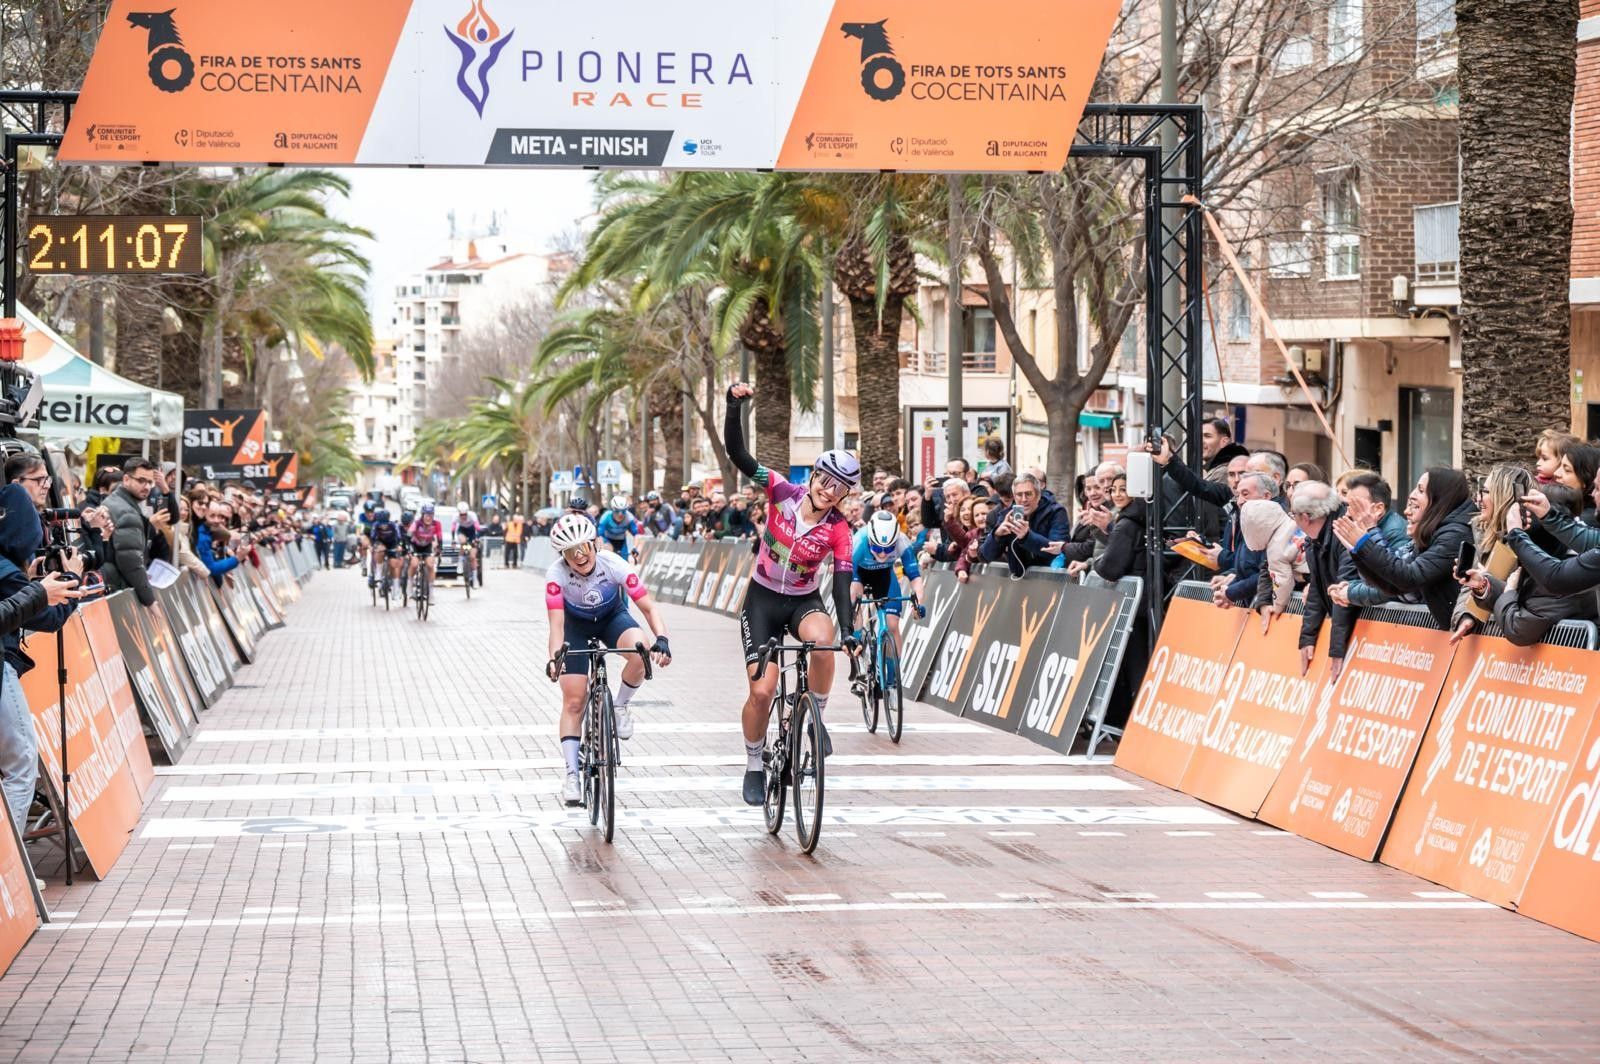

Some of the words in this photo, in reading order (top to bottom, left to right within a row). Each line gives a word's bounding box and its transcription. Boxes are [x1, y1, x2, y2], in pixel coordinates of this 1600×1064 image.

[200, 56, 236, 68] FIRA
[241, 56, 262, 68] DE
[266, 57, 306, 68] TOTS
[311, 58, 362, 70] SANTS
[522, 50, 753, 85] PIONERA
[911, 65, 945, 77] FIRA
[950, 66, 970, 78] DE
[975, 66, 1013, 78] TOTS
[1018, 66, 1066, 78] SANTS
[200, 72, 362, 93] COCENTAINA
[911, 82, 1067, 101] COCENTAINA
[572, 92, 703, 108] RACE
[196, 129, 234, 139] Diputació
[196, 140, 206, 148] de
[208, 140, 241, 148] València
[291, 132, 338, 140] DIPUTACIÓN
[911, 137, 948, 147] Diputació
[1002, 139, 1048, 148] DIPUTACIÓN
[302, 142, 338, 150] ALICANTE
[511, 135, 566, 155] META
[581, 136, 648, 156] FINISH
[911, 148, 921, 156] de
[922, 148, 954, 156] València
[29, 224, 188, 269] 2:11:07
[774, 514, 821, 554] LABORAL
[1356, 637, 1397, 664] Comunitat
[1392, 643, 1435, 672] Valenciana
[1484, 653, 1534, 686] Comunitat
[1532, 661, 1588, 694] Valenciana
[1339, 668, 1425, 721] COMUNITAT
[1148, 701, 1168, 732] DE
[1160, 707, 1207, 746] ALICANTE
[1466, 690, 1576, 751] COMUNITAT
[1218, 720, 1241, 754] DE
[1326, 713, 1353, 753] DE
[1344, 717, 1417, 769] L'ESPORT
[1228, 727, 1296, 771] ALICANTE
[1454, 741, 1487, 786] DE
[1478, 746, 1569, 806] L'ESPORT
